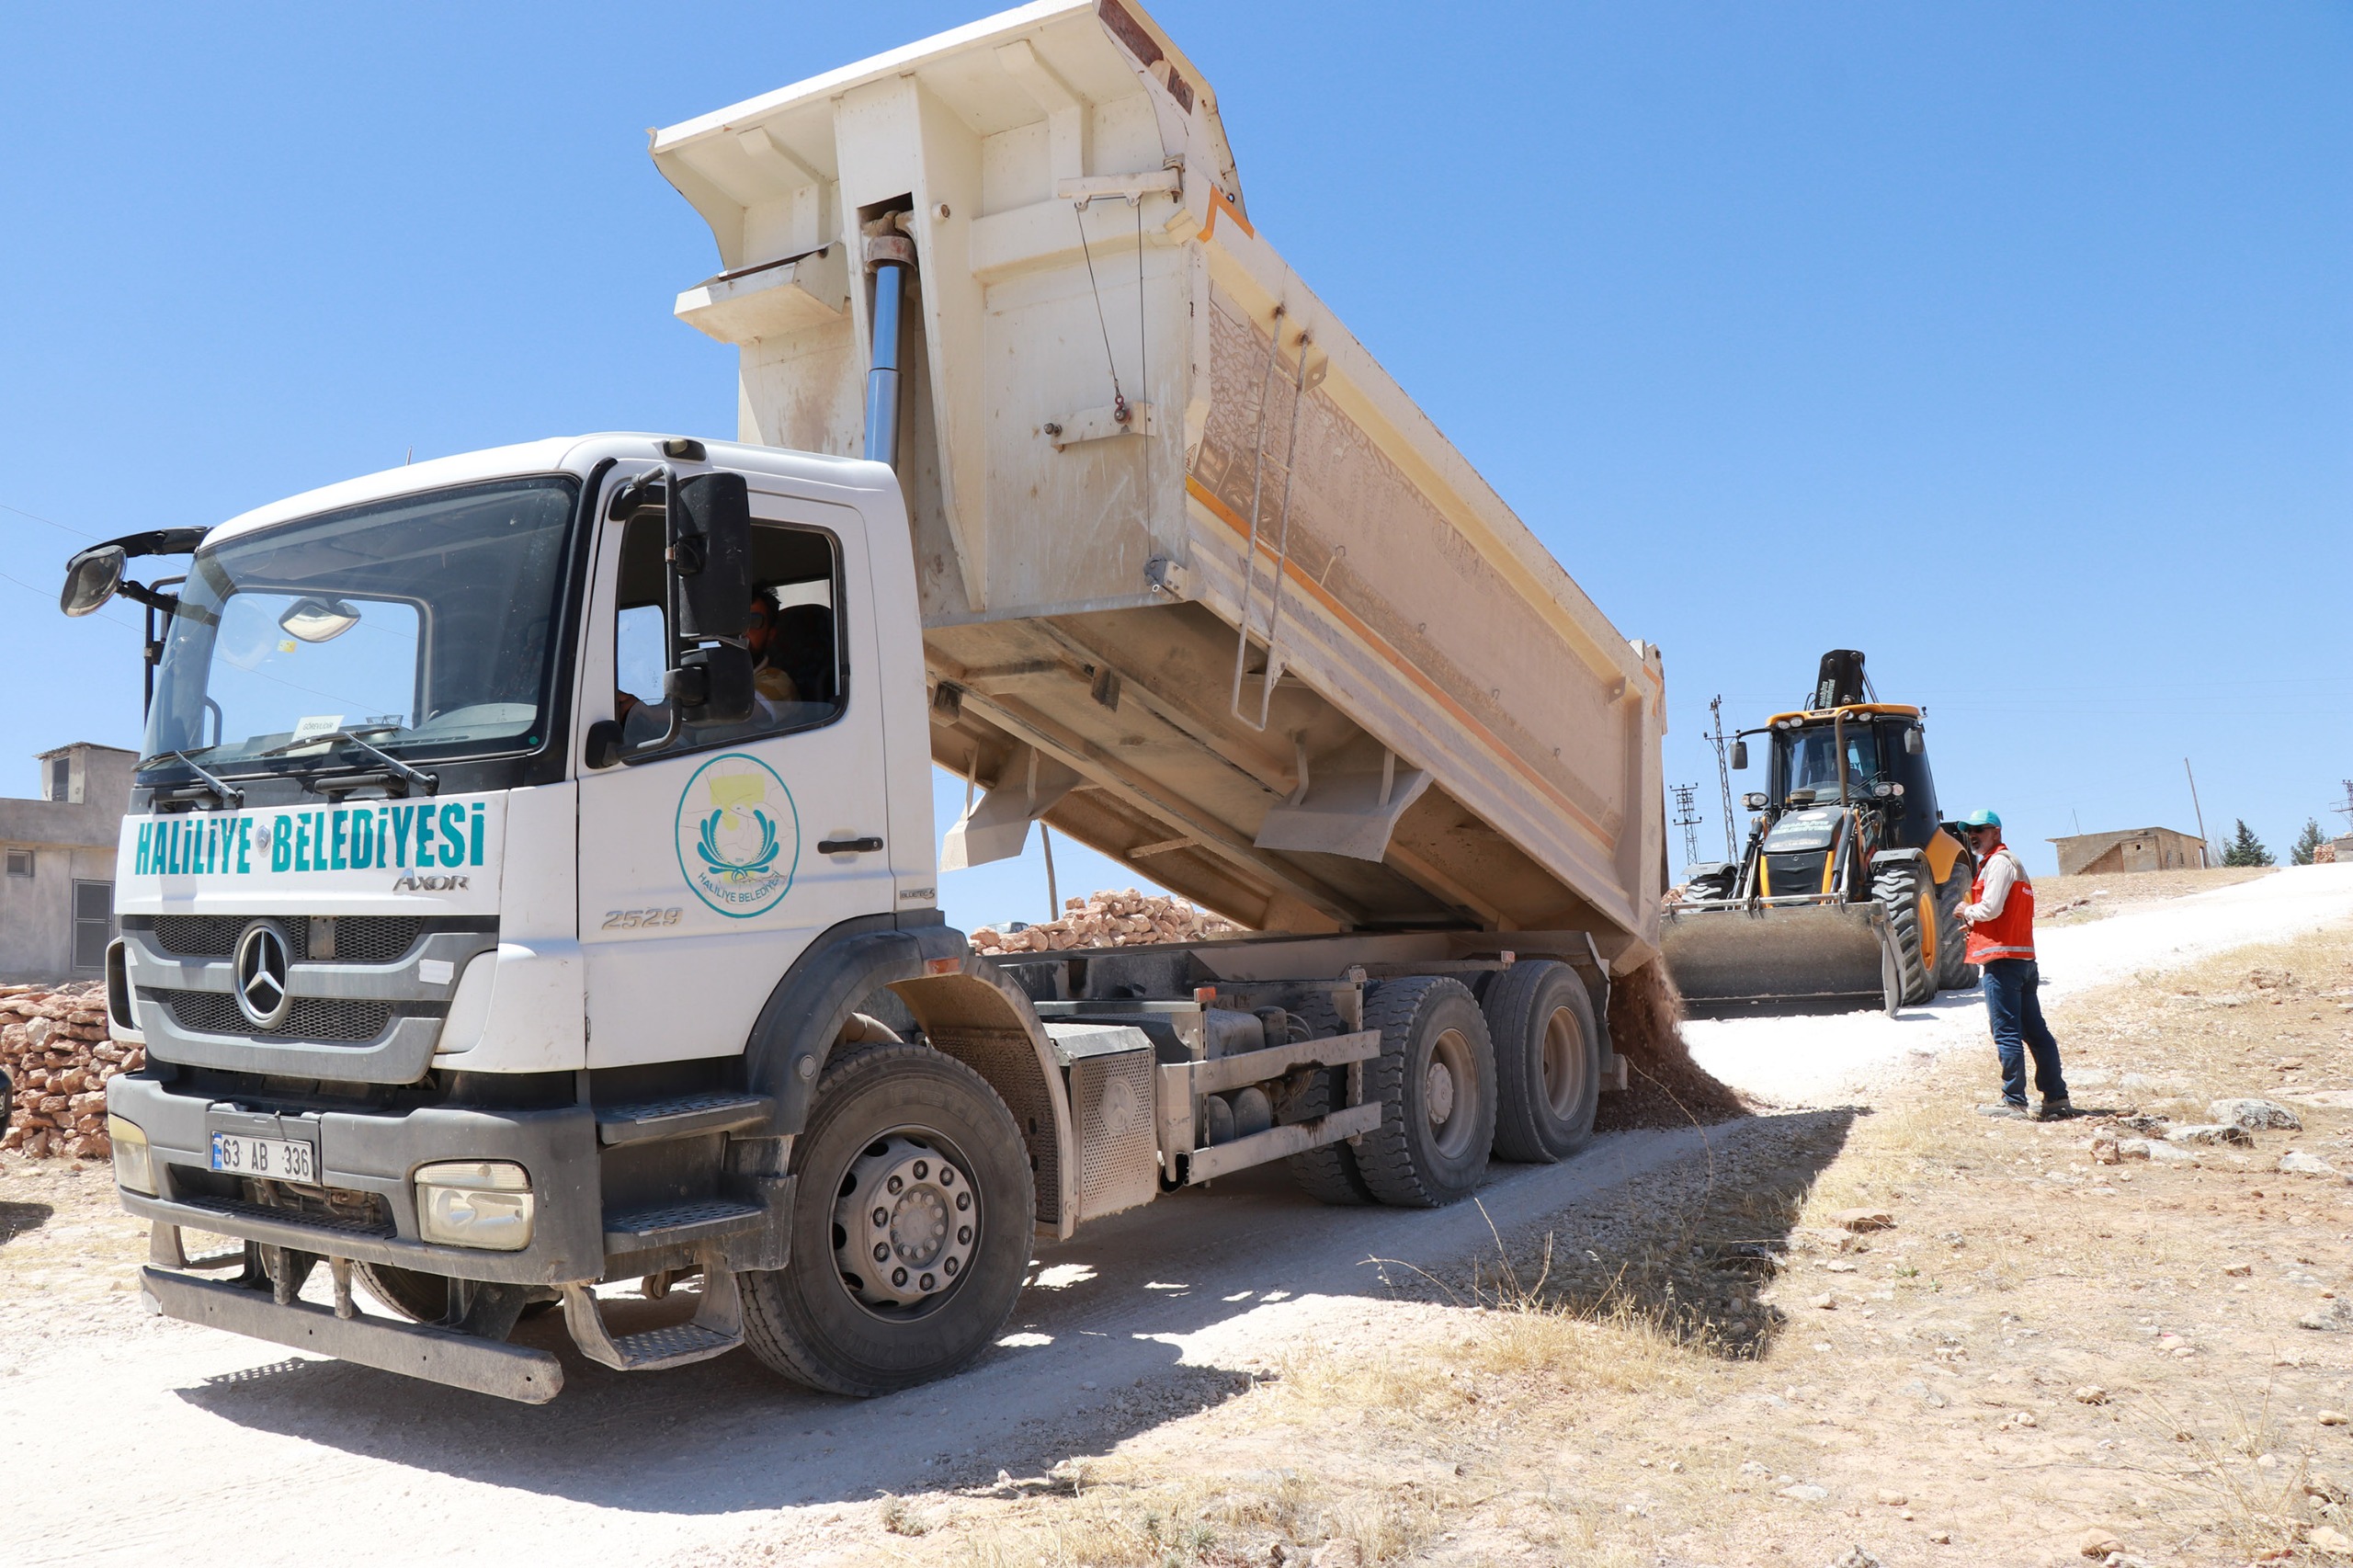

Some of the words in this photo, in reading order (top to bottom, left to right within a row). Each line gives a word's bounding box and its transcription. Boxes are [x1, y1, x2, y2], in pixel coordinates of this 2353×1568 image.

[136, 817, 253, 875] HALİLİYE
[271, 802, 485, 872] BELEDİYESİ
[392, 869, 470, 891] AXOR
[601, 907, 683, 929] 2529
[214, 1153, 222, 1163] TR
[223, 1139, 240, 1167] 63
[251, 1142, 268, 1171] AB
[284, 1145, 310, 1176] 336
